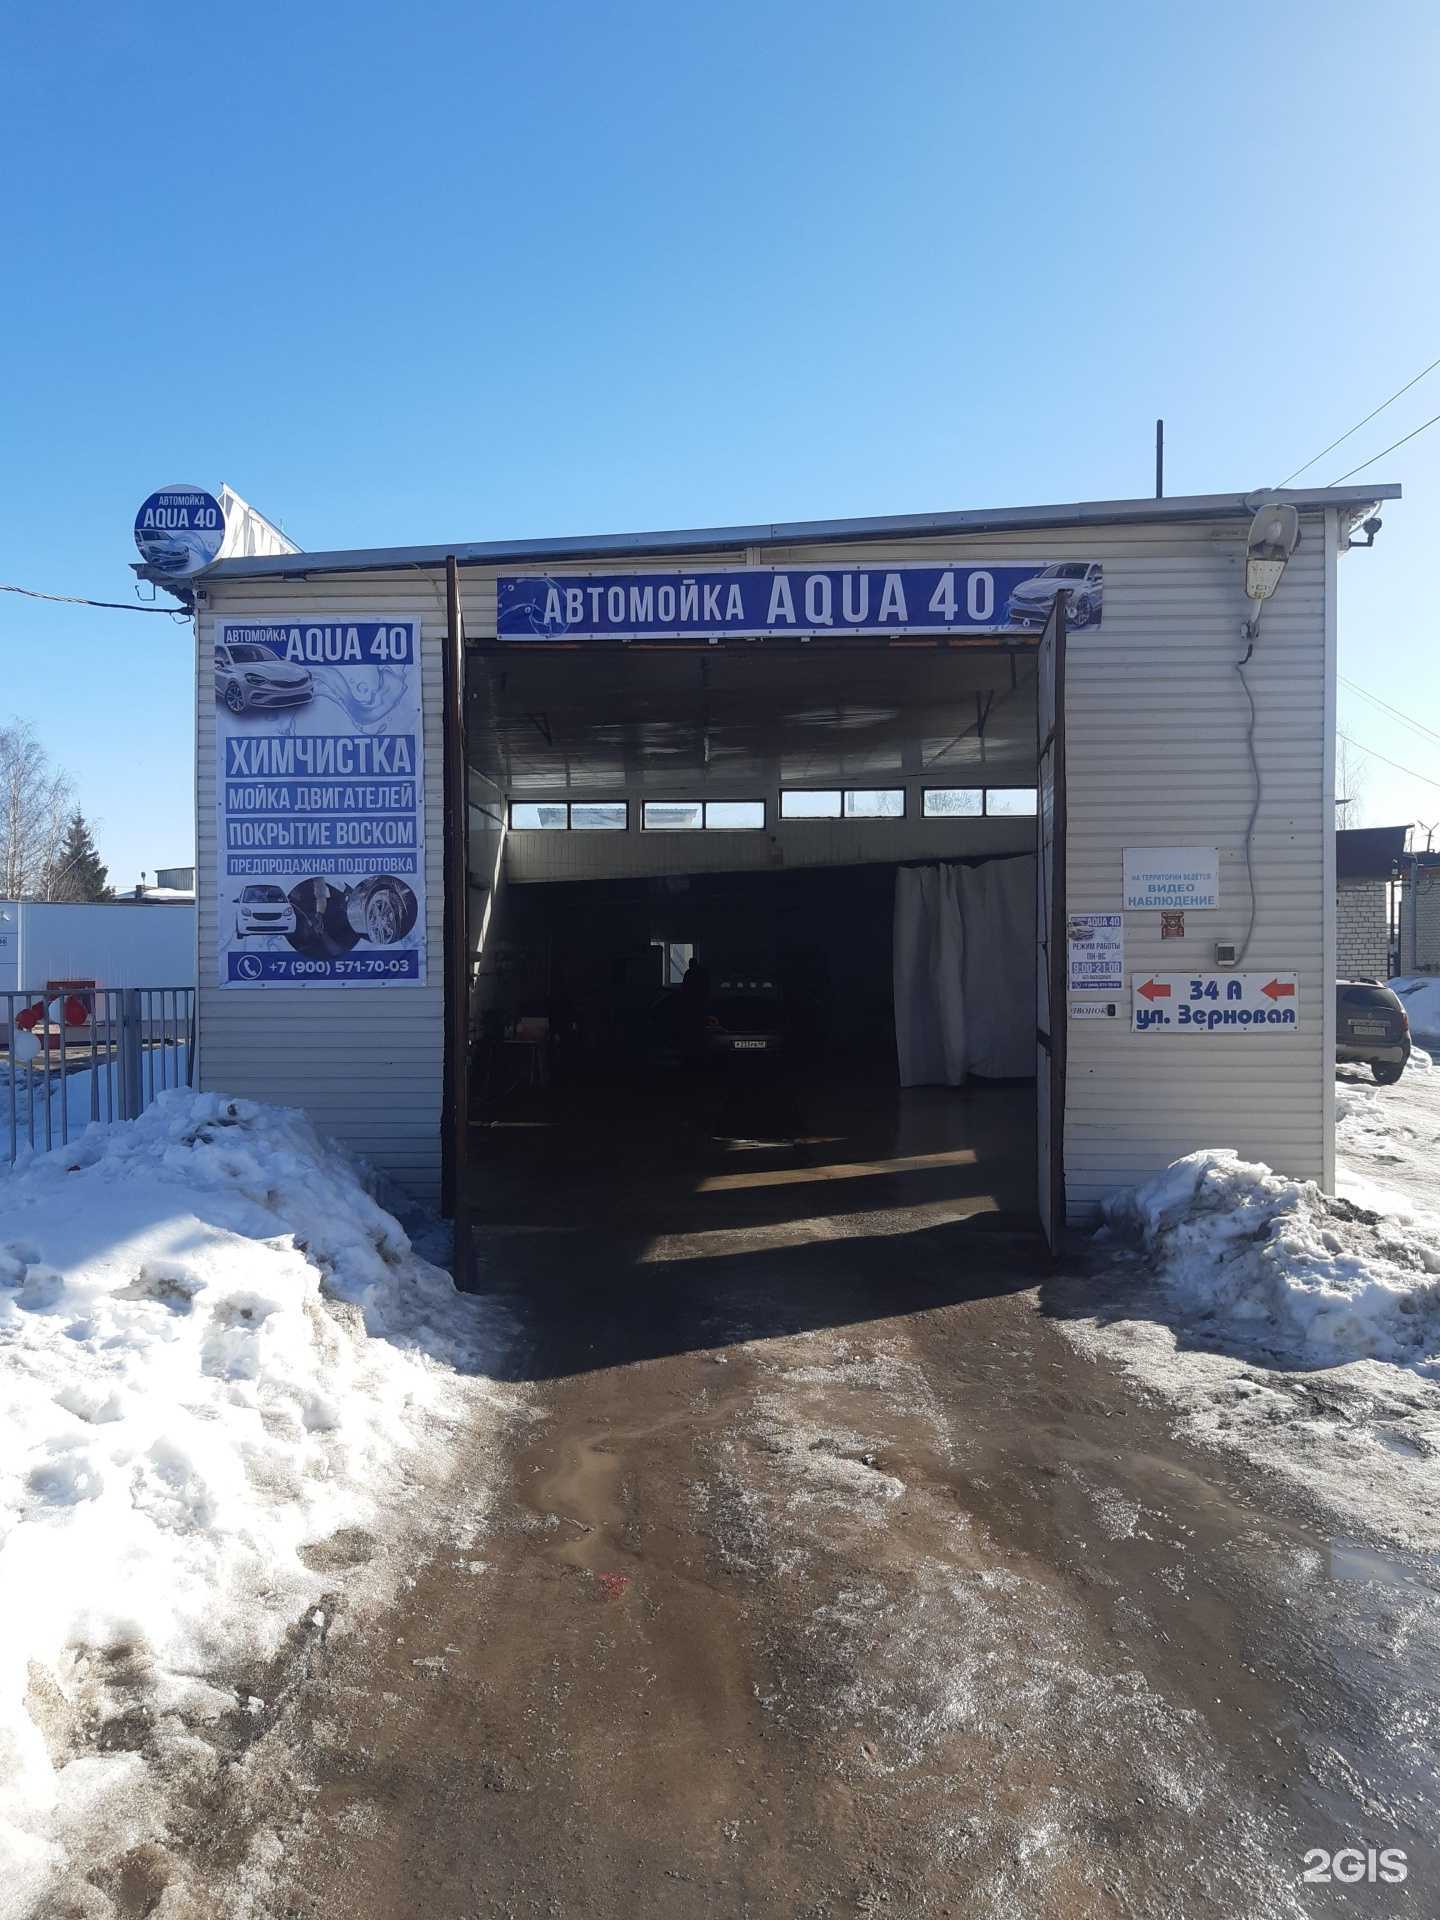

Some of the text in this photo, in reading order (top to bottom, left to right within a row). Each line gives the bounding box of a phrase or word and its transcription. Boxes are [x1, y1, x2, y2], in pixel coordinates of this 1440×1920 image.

[158, 494, 206, 506] АВТОМОЙКА
[143, 508, 217, 529] AQUA 40
[543, 571, 995, 626] АВТОМОЙКА AQUA 40
[226, 627, 407, 662] АВТОМОЙКА AQUA 40
[230, 737, 413, 775] ХИМЧИСТКА
[229, 783, 413, 811] МОЙКА ДВИГАТЕЛЕЙ
[229, 821, 413, 846] ПОКРЫТИЕ ВОСКОМ
[230, 856, 413, 874] ПРЕДПРОДАЖНАЯ ПОДГОТОВКА
[1147, 883, 1195, 894] ВИДЕО
[1128, 895, 1215, 907] НАБЛЮДЕНИЕ
[269, 960, 409, 976] +7 (900) 571-70-03
[1190, 980, 1219, 1001] 34
[1136, 1005, 1296, 1030] ул. Зерновая
